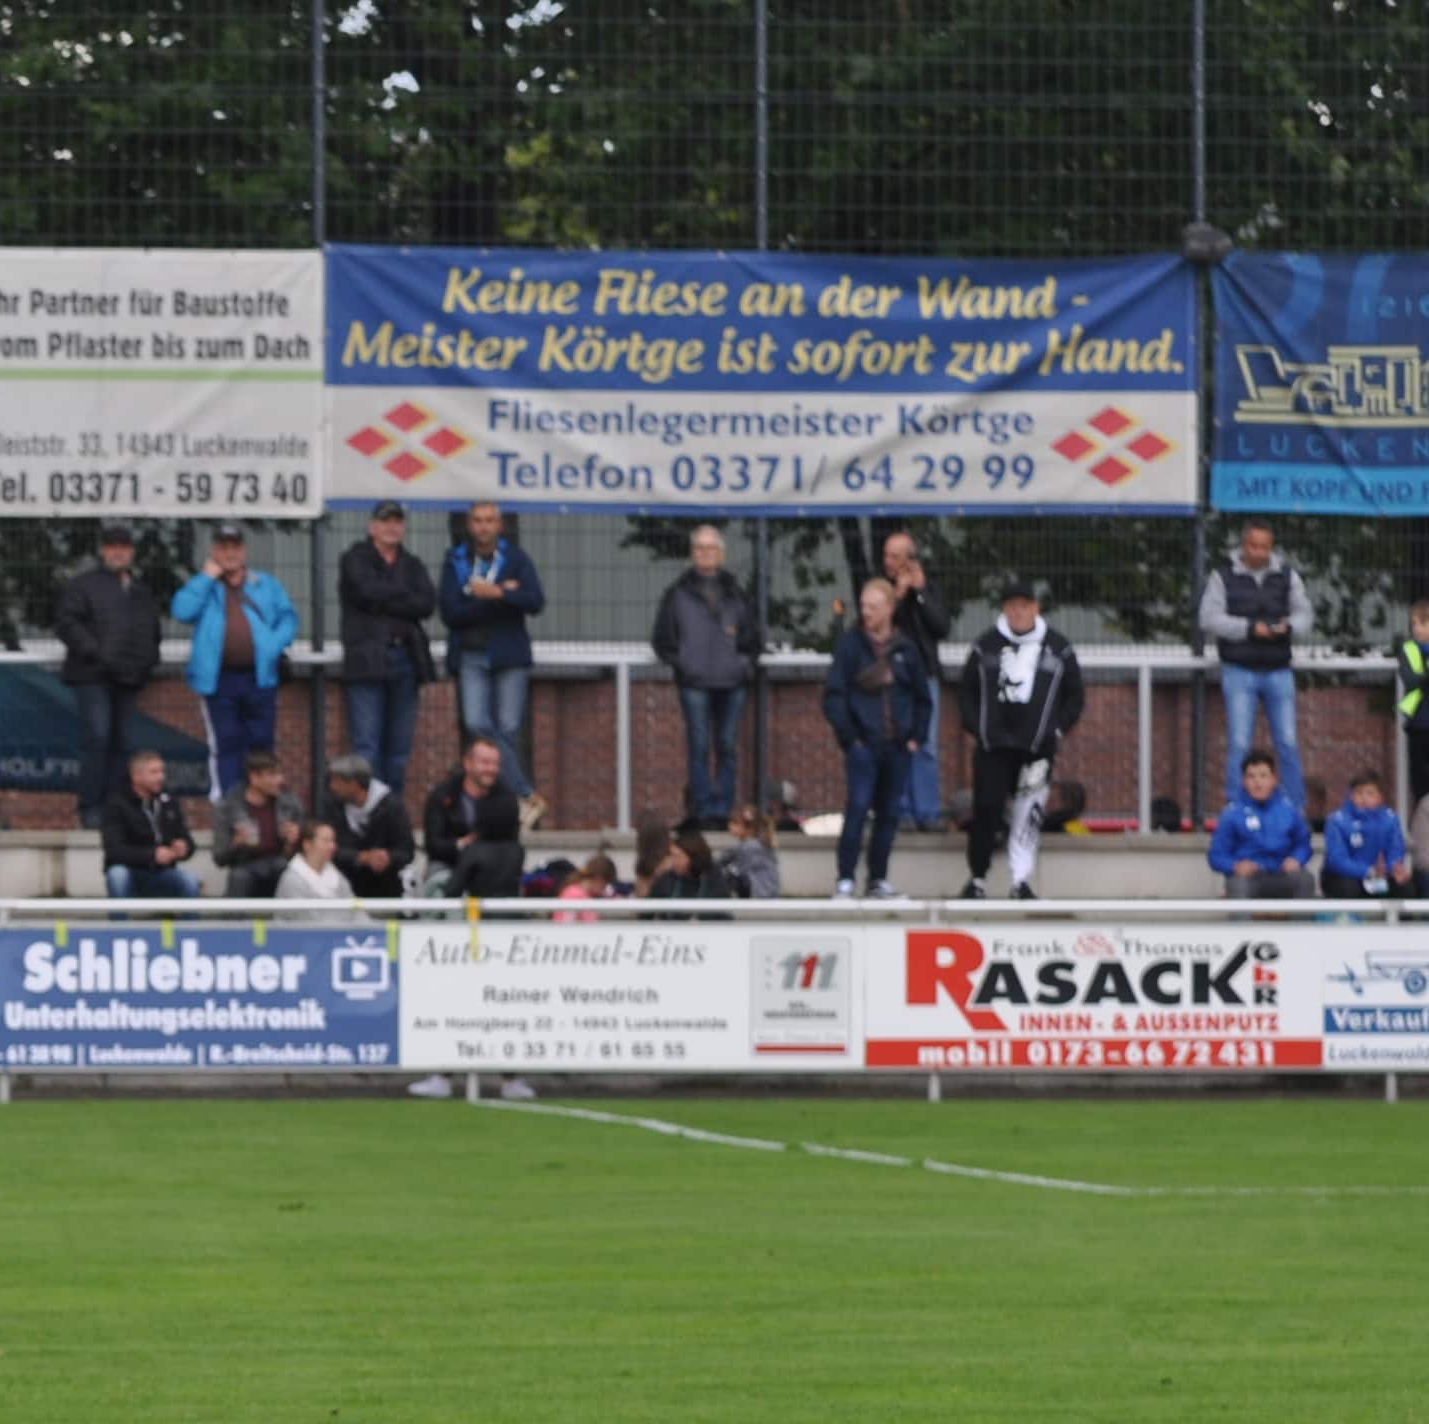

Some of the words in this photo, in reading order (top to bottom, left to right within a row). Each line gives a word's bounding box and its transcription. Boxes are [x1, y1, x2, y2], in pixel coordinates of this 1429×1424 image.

[29, 289, 120, 317] Partner
[129, 289, 164, 317] für
[172, 290, 289, 318] Baustoffe
[442, 267, 581, 316] Keine
[593, 269, 729, 317] Fliese
[739, 283, 806, 317] an
[818, 275, 902, 319] der
[917, 275, 1060, 320] Wand
[48, 331, 142, 360] Pflaster
[151, 332, 186, 360] bis
[194, 337, 243, 360] zum
[254, 333, 310, 360] Dach
[342, 320, 529, 371] Meister
[538, 325, 704, 384] Körtge
[716, 326, 778, 374] ist
[787, 330, 936, 383] sofort
[945, 338, 1033, 383] zur
[1038, 323, 1186, 376] Hand.
[487, 399, 884, 446] Fliesenlegermeister
[897, 404, 1035, 446] Körtge
[181, 432, 309, 459] Luckenwalde
[487, 450, 653, 491] Telefon
[842, 454, 895, 491] 64
[915, 454, 966, 491] 29
[983, 454, 1036, 491] 99
[48, 472, 141, 503] 03371
[176, 472, 212, 503] 59
[224, 472, 260, 503] 73
[271, 472, 308, 503] 40
[1235, 476, 1280, 498] MIT
[414, 933, 707, 967] Auto-Einmal-Eins
[991, 938, 1068, 957] Frank
[1121, 938, 1224, 957] Thomas
[22, 937, 307, 995] Schliebner
[904, 928, 1253, 1031] RASACK
[482, 986, 550, 1004] Rainer
[559, 986, 660, 1004] Wendrich
[4, 1000, 326, 1035] Unterhaltungselektronik
[1138, 1012, 1280, 1033] AUSSENPUTZ
[917, 1039, 1012, 1066] mobil
